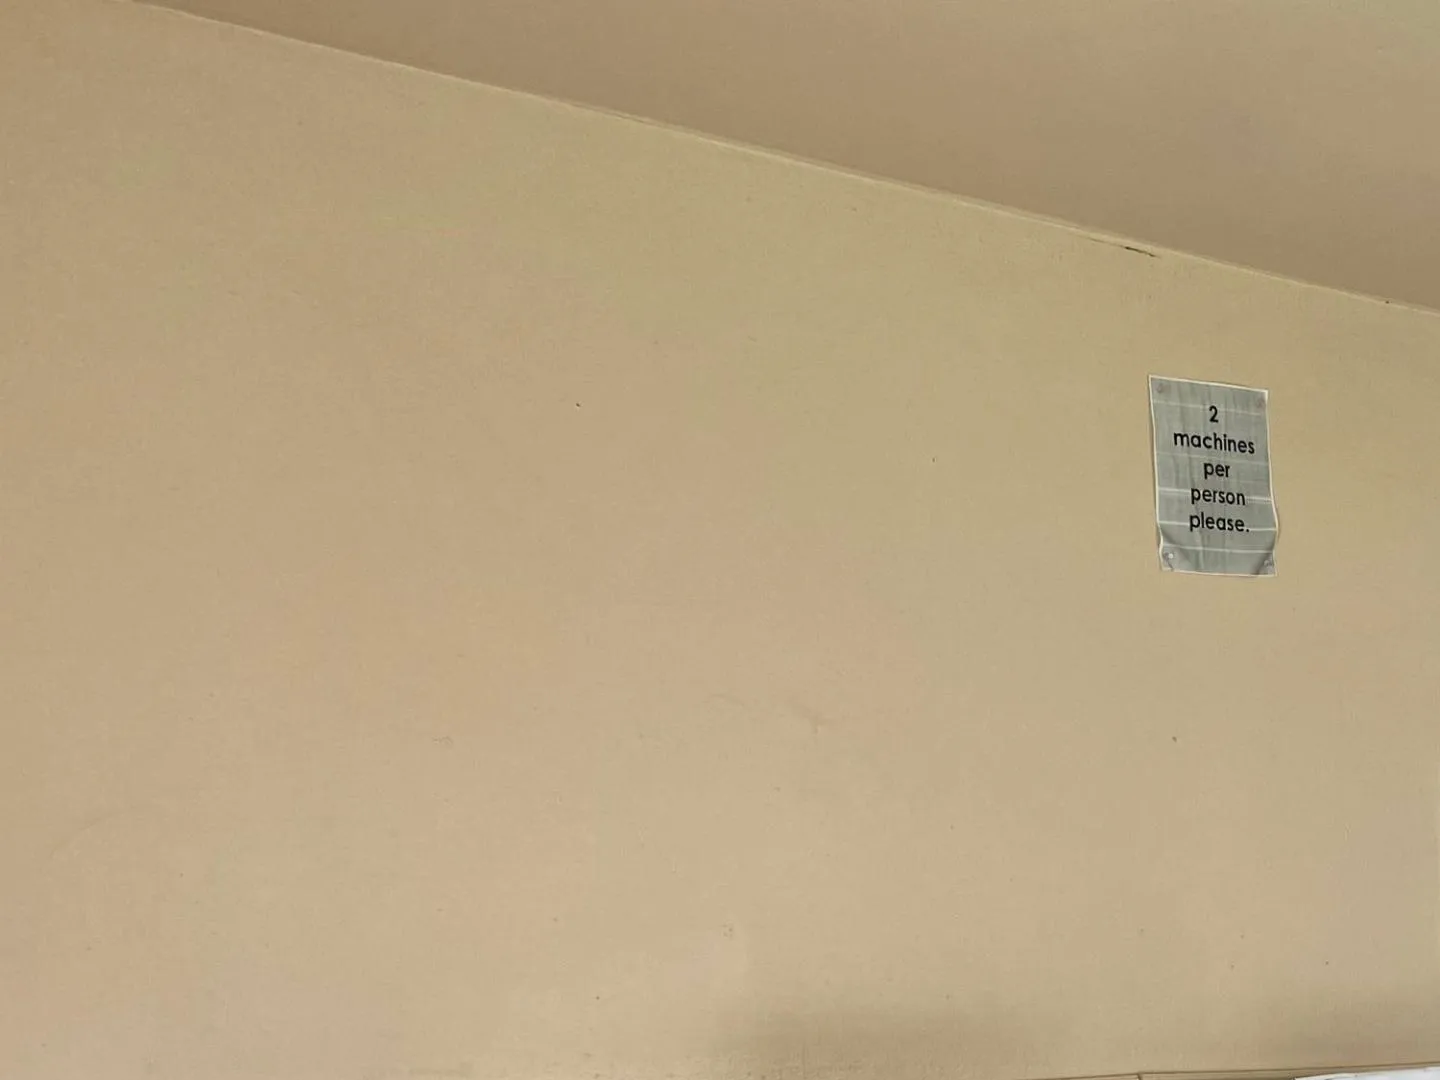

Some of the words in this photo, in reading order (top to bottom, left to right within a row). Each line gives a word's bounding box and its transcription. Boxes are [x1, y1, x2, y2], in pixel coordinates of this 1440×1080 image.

[1208, 405, 1219, 423] 2
[1173, 432, 1255, 454] machines
[1203, 462, 1230, 480] per
[1191, 487, 1246, 506] person
[1189, 512, 1250, 532] please.
